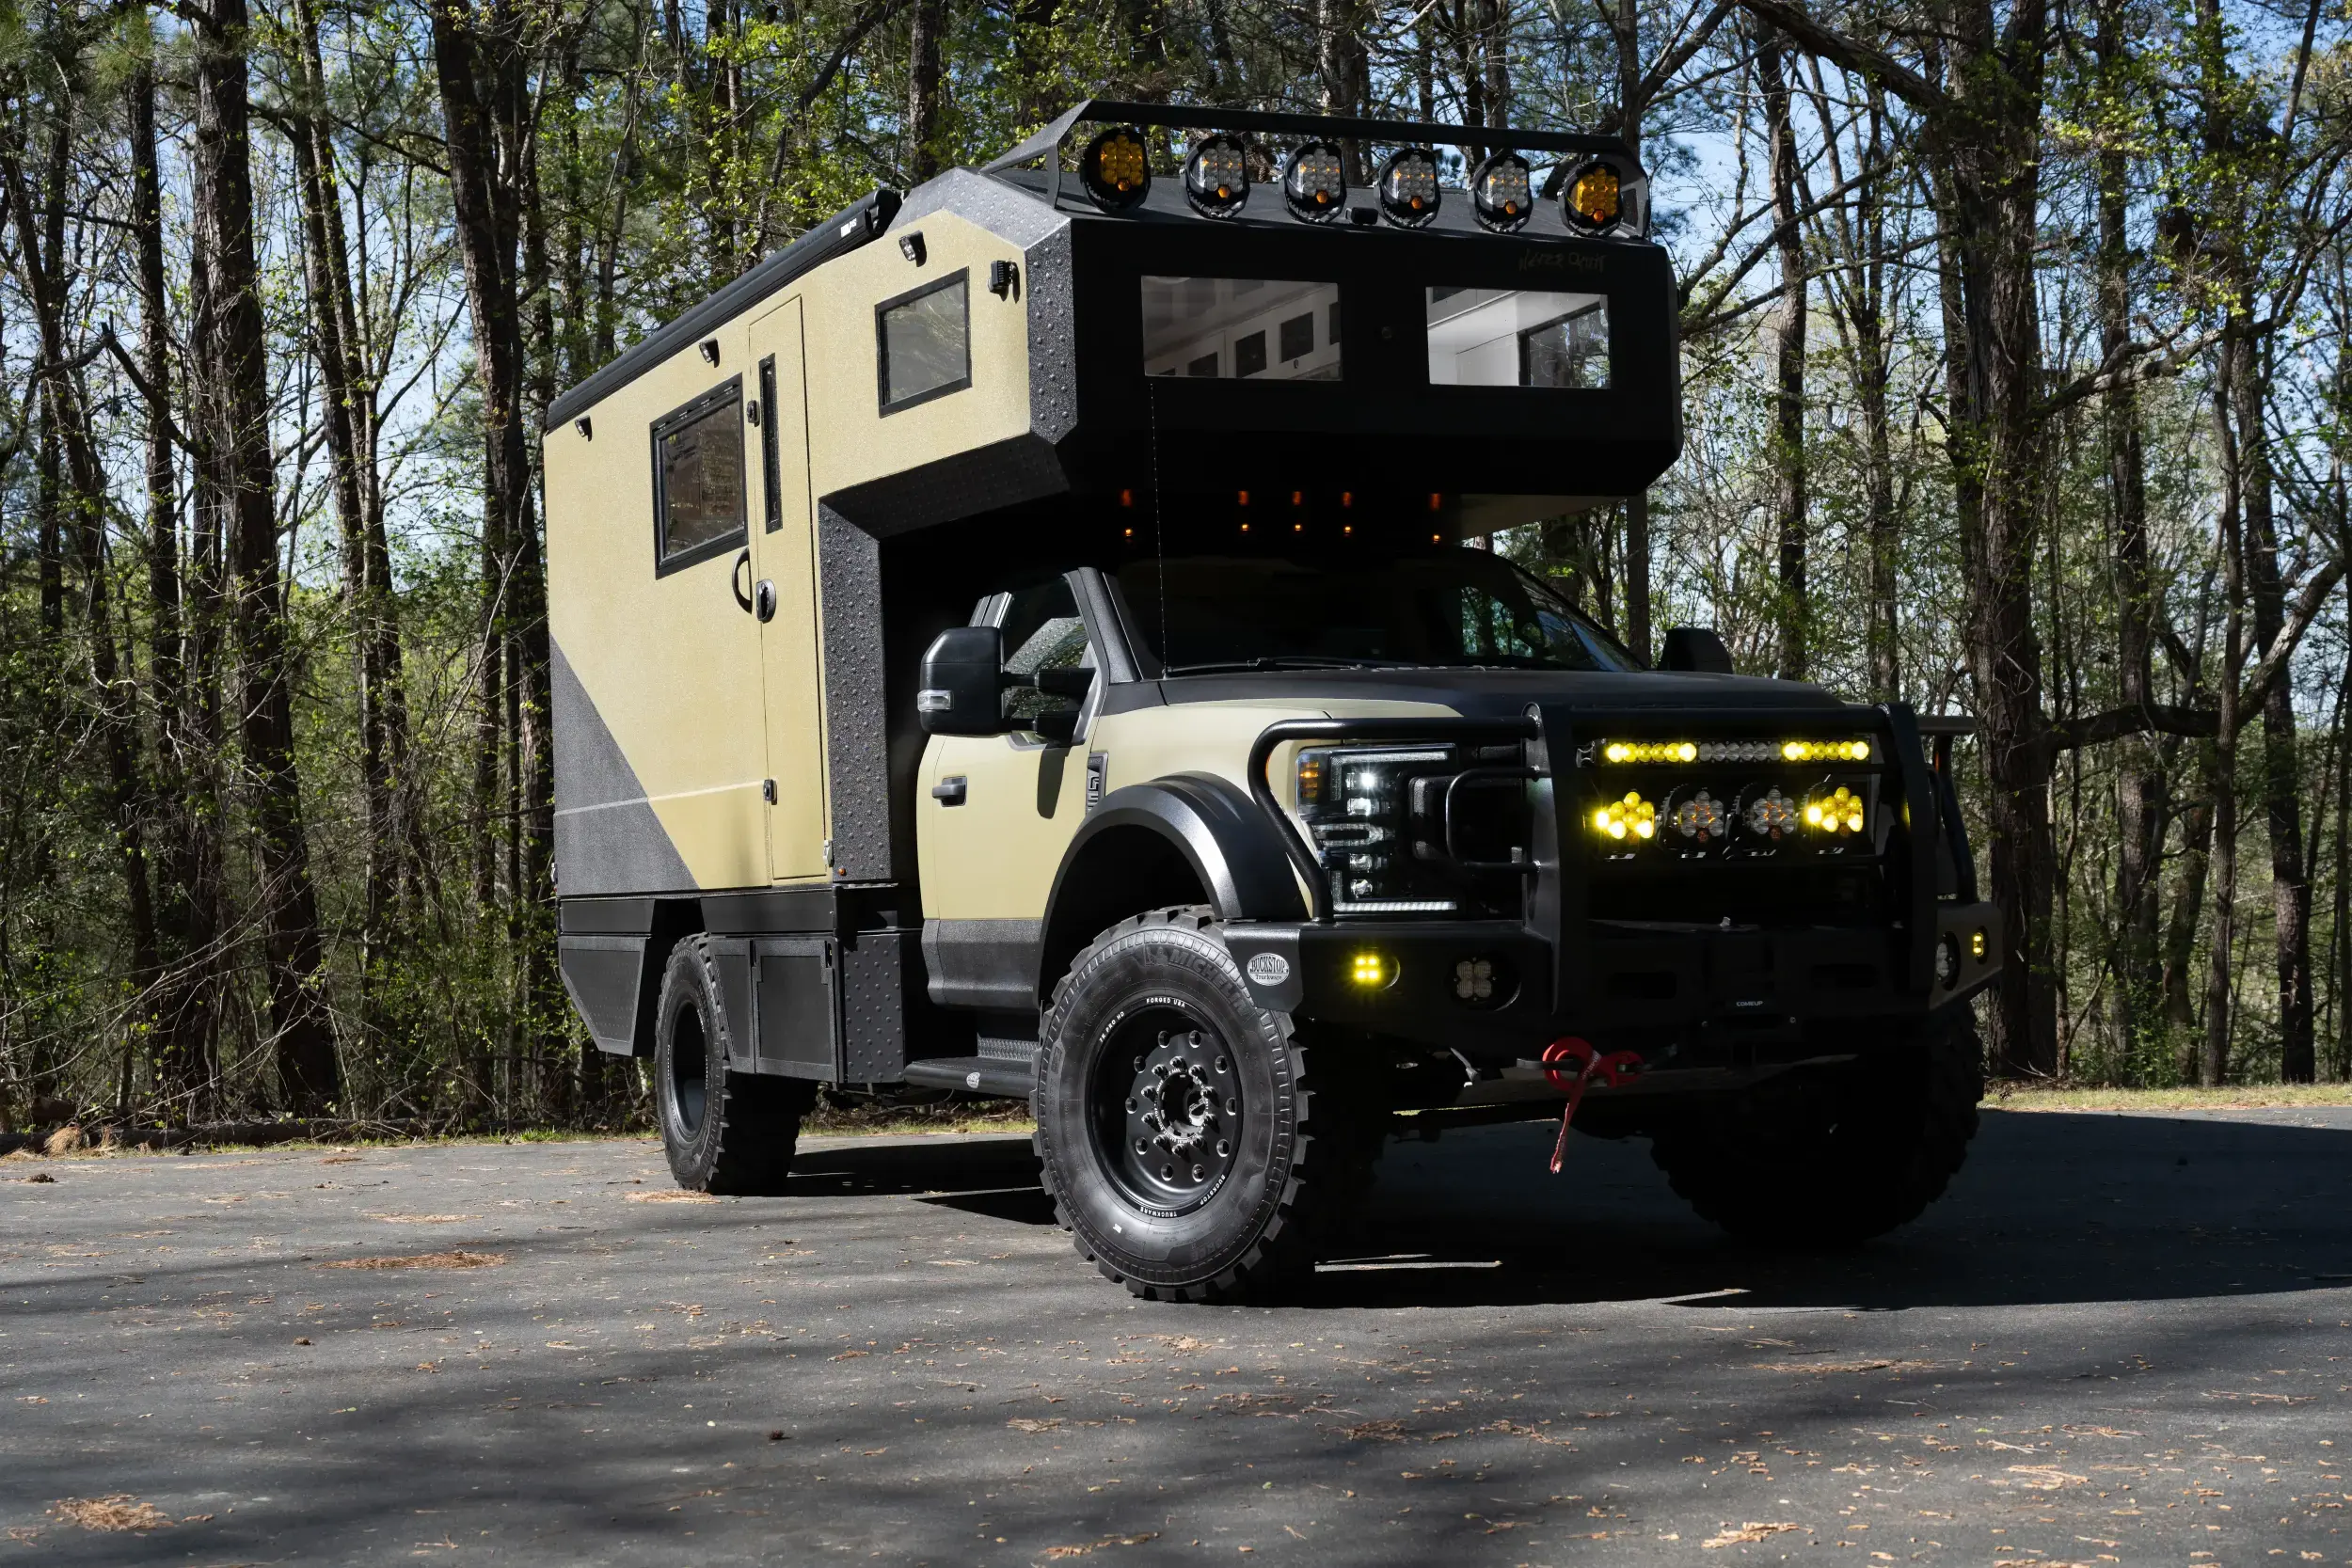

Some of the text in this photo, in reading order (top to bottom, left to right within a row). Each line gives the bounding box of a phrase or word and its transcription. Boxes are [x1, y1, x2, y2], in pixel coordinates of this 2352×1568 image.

[1249, 956, 1286, 974] BUCKSTOP
[1169, 948, 1247, 1017] MICHELIN
[1173, 999, 1185, 1008] USA
[1104, 1019, 1116, 1033] PRO
[1116, 1010, 1125, 1021] HD
[1200, 1174, 1226, 1206] BUCKSTOP
[1139, 1206, 1178, 1218] TRUCKWARE
